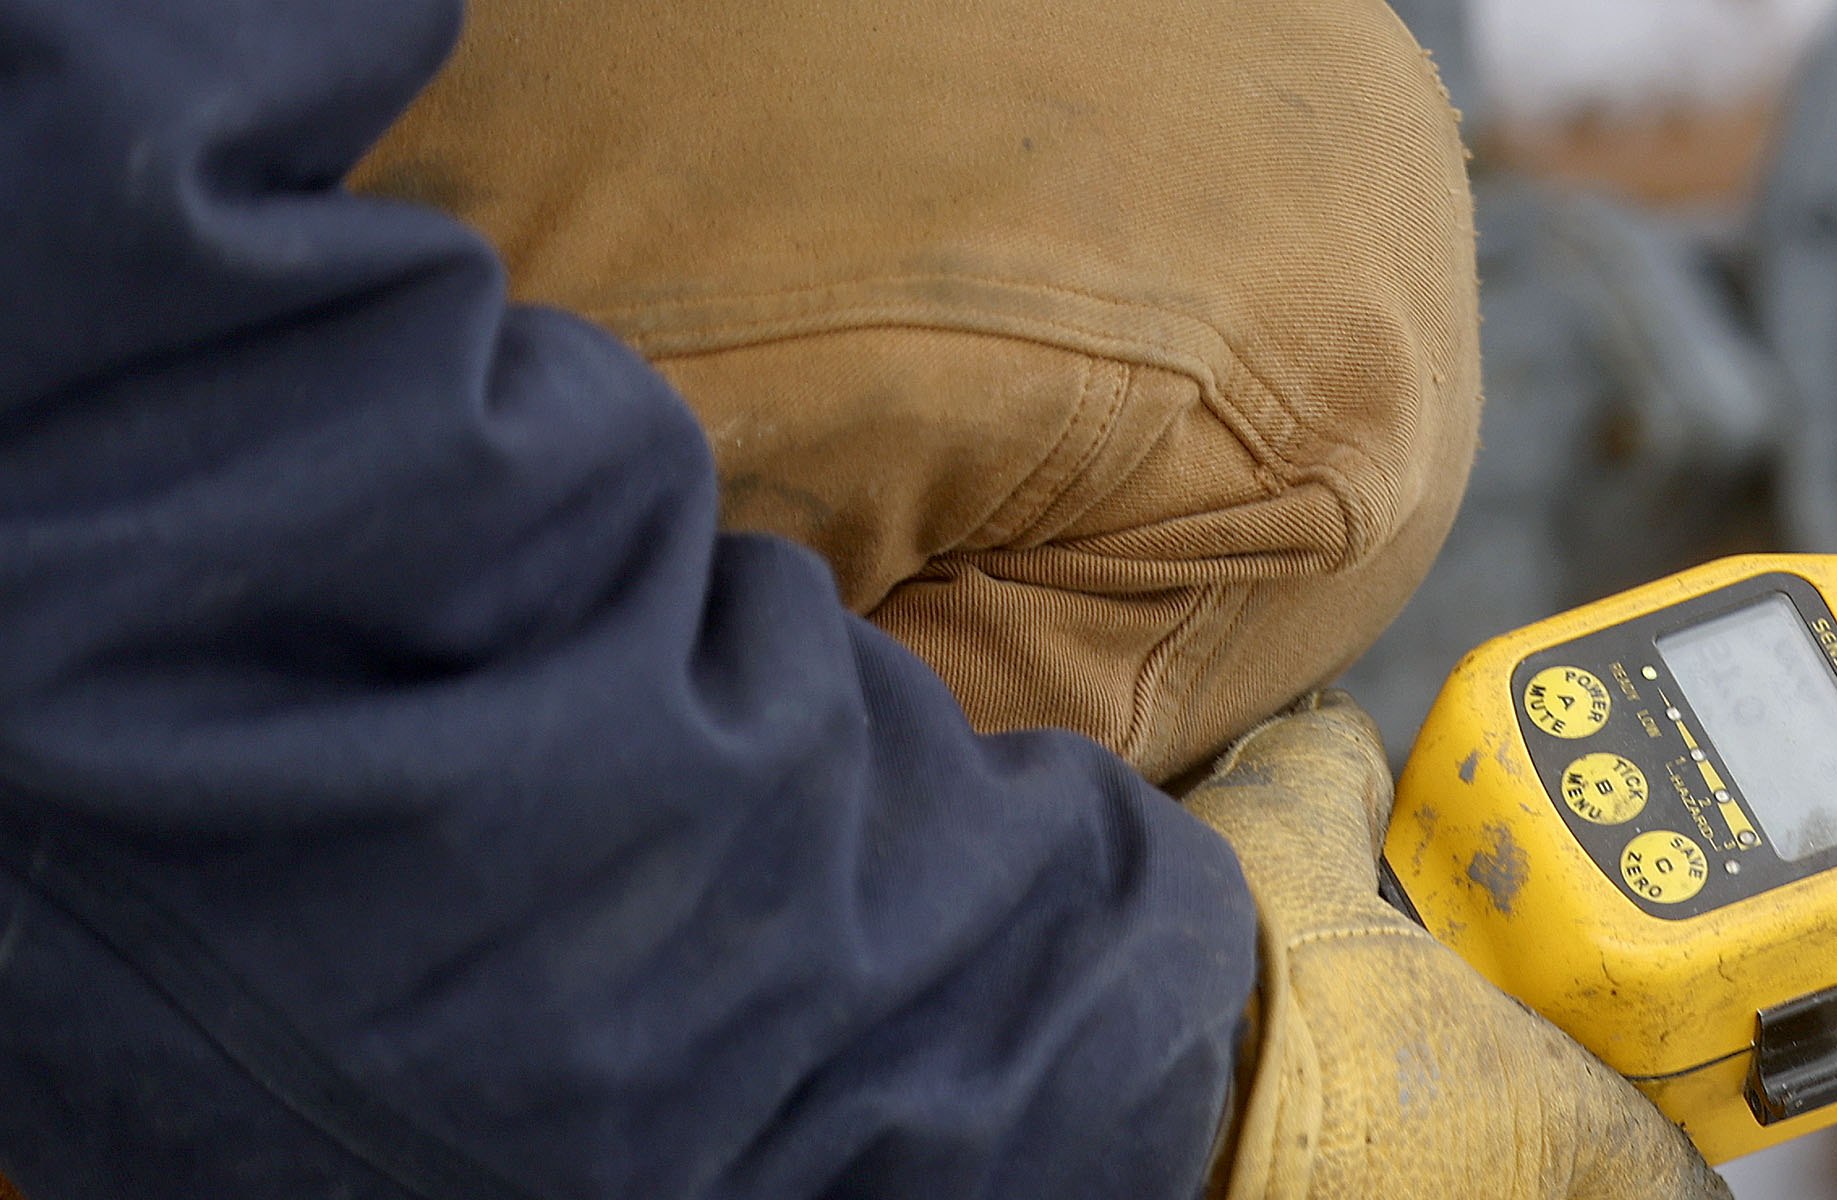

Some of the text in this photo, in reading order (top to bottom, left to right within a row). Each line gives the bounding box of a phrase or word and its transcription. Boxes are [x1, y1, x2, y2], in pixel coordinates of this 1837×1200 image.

[1529, 684, 1566, 734] MUTE
[1557, 694, 1576, 711] A
[1564, 671, 1607, 723] POWER
[1567, 772, 1602, 820] MENU
[1595, 779, 1613, 795] B
[1613, 759, 1644, 801] TICK
[1671, 774, 1714, 839] HAZARD
[1626, 851, 1663, 898] ZERO
[1655, 857, 1673, 874] C
[1670, 836, 1705, 880] SAVE
